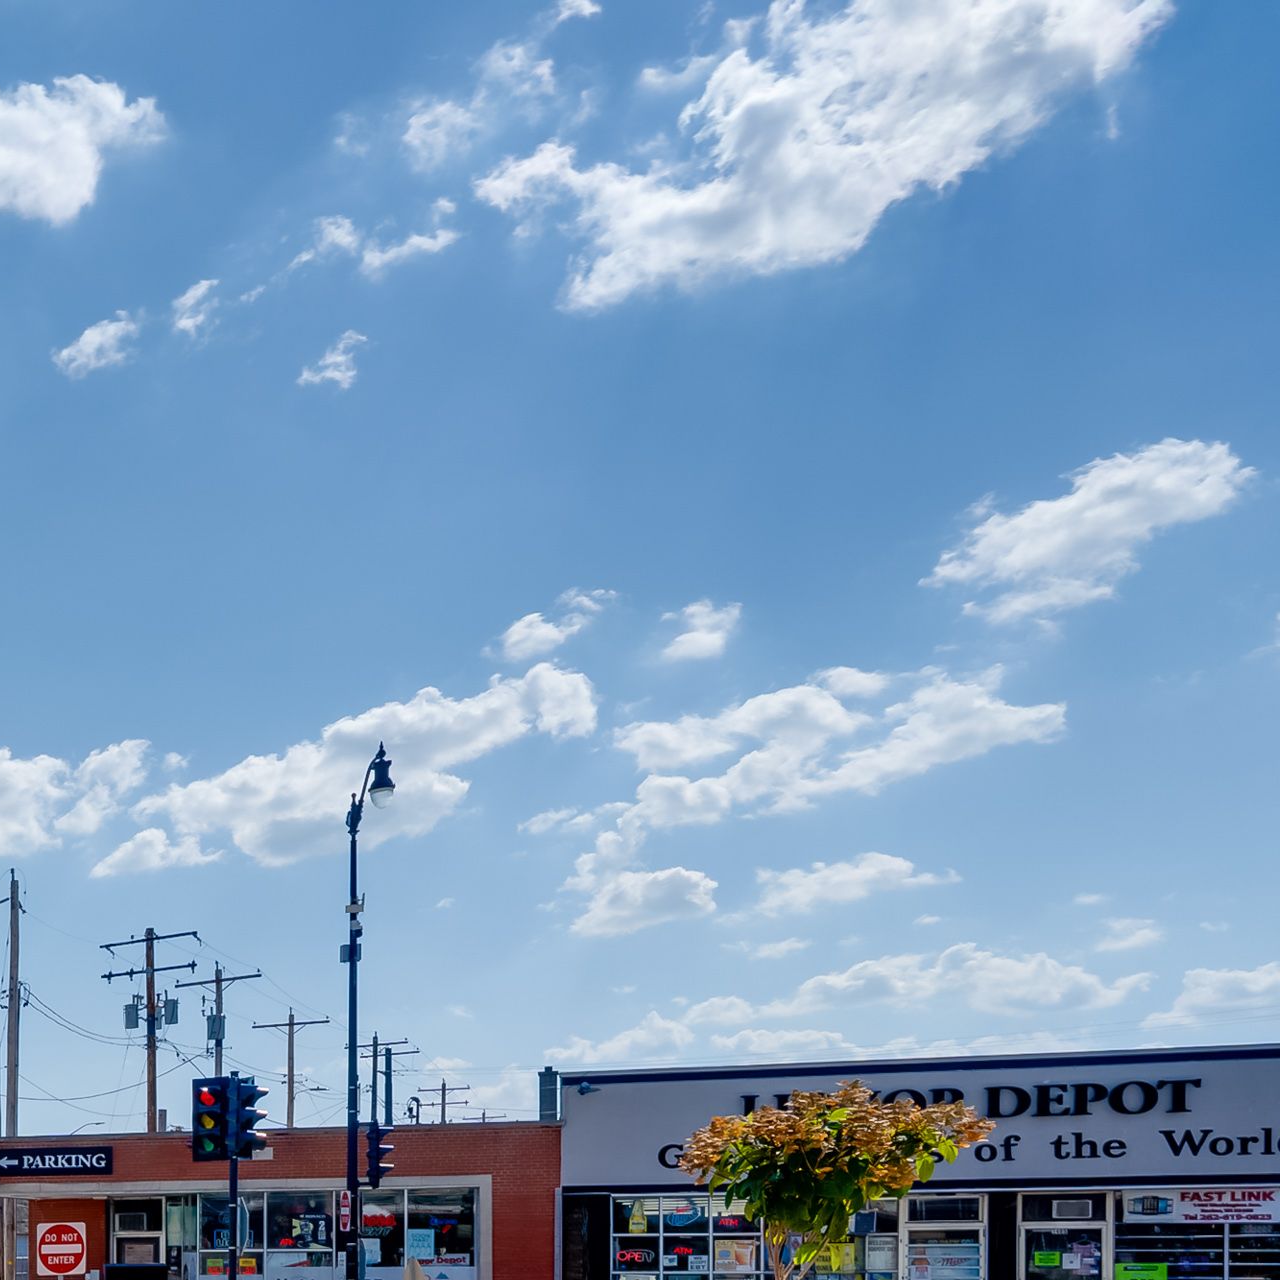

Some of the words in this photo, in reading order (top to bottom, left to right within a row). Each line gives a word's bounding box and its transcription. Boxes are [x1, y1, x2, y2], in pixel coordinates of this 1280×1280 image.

[984, 1078, 1202, 1118] DEPOT
[974, 1135, 1021, 1162] of
[1050, 1132, 1127, 1159] the
[1158, 1127, 1280, 1156] Worl
[22, 1153, 106, 1169] PARKING
[1180, 1191, 1225, 1202] FAST
[1230, 1191, 1275, 1202] LINK
[719, 1218, 738, 1226] ATM
[45, 1234, 57, 1242] DO
[62, 1233, 78, 1242] NOT
[673, 1247, 693, 1255] ATM
[48, 1255, 75, 1265] ENTER
[437, 1256, 466, 1264] Depot
[616, 1250, 653, 1263] OPEN
